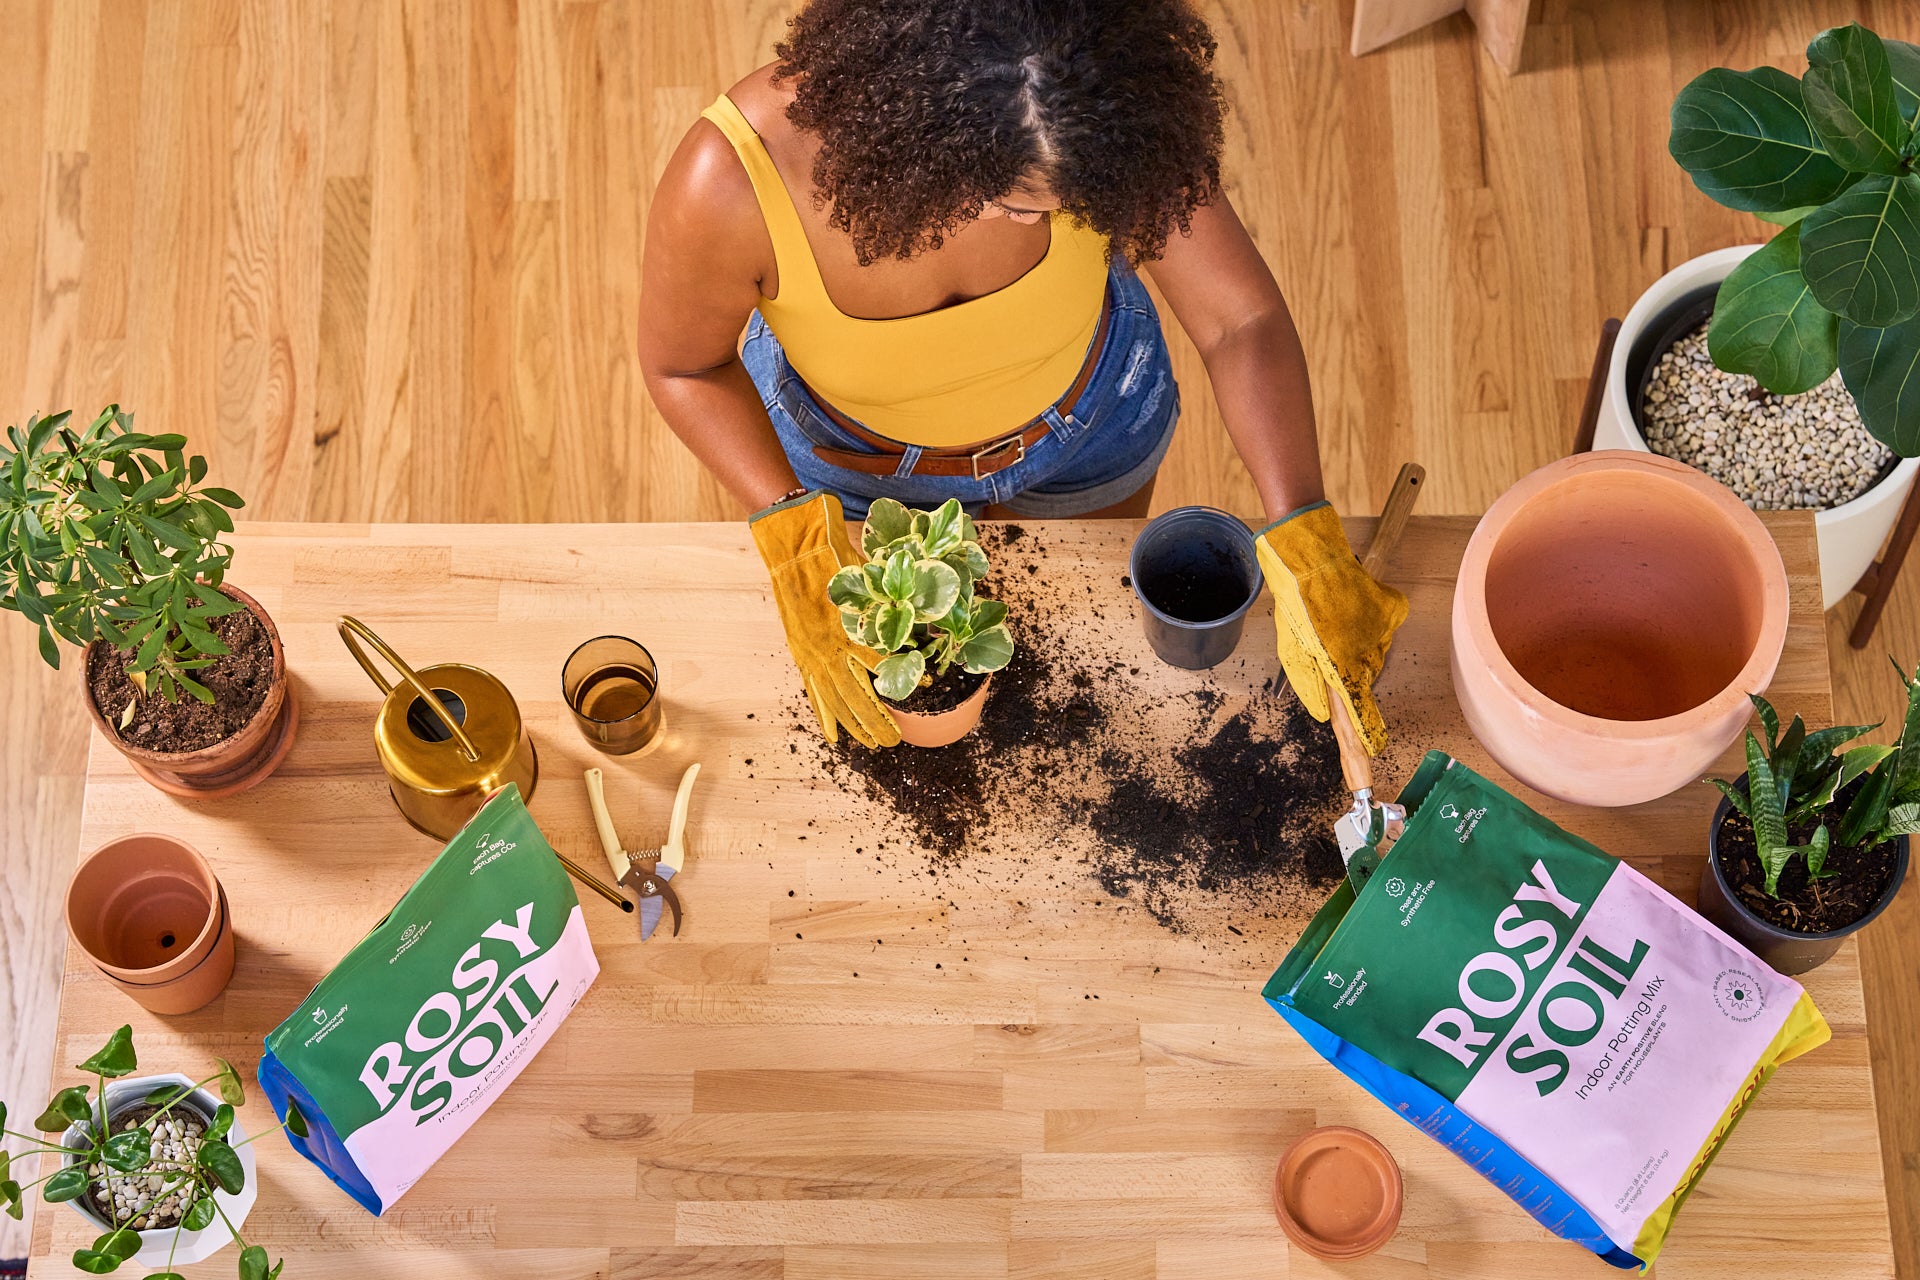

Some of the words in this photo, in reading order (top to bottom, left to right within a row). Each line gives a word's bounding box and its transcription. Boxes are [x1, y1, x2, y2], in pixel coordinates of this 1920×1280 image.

[1458, 818, 1479, 844] Captures
[1464, 808, 1477, 822] Bag
[489, 839, 506, 852] Bag
[1399, 896, 1413, 913] Peat
[1409, 882, 1423, 899] and
[1400, 894, 1426, 927] Synthetic
[1422, 879, 1436, 896] Free
[1415, 858, 1583, 1070] ROSY
[358, 902, 540, 1112] ROSY
[1332, 967, 1367, 1010] Professionally
[1345, 981, 1368, 1007] Blended
[304, 1004, 348, 1048] Professionally
[315, 1016, 344, 1043] Blended
[1506, 934, 1651, 1098] SOIL
[1575, 1052, 1614, 1100] Indoor
[1608, 1000, 1652, 1053] Potting
[1641, 975, 1665, 1002] Mix
[410, 979, 559, 1128] SOIL
[438, 1085, 482, 1124] Indoor
[530, 1010, 548, 1035] Mix
[1607, 1081, 1617, 1092] AN
[1615, 1057, 1634, 1080] EARTH
[1631, 1026, 1654, 1057] POSITIVE
[1650, 1004, 1668, 1027] BLEND
[1622, 1070, 1635, 1086] FOR
[1634, 1021, 1667, 1071] HOUSEPLANTS
